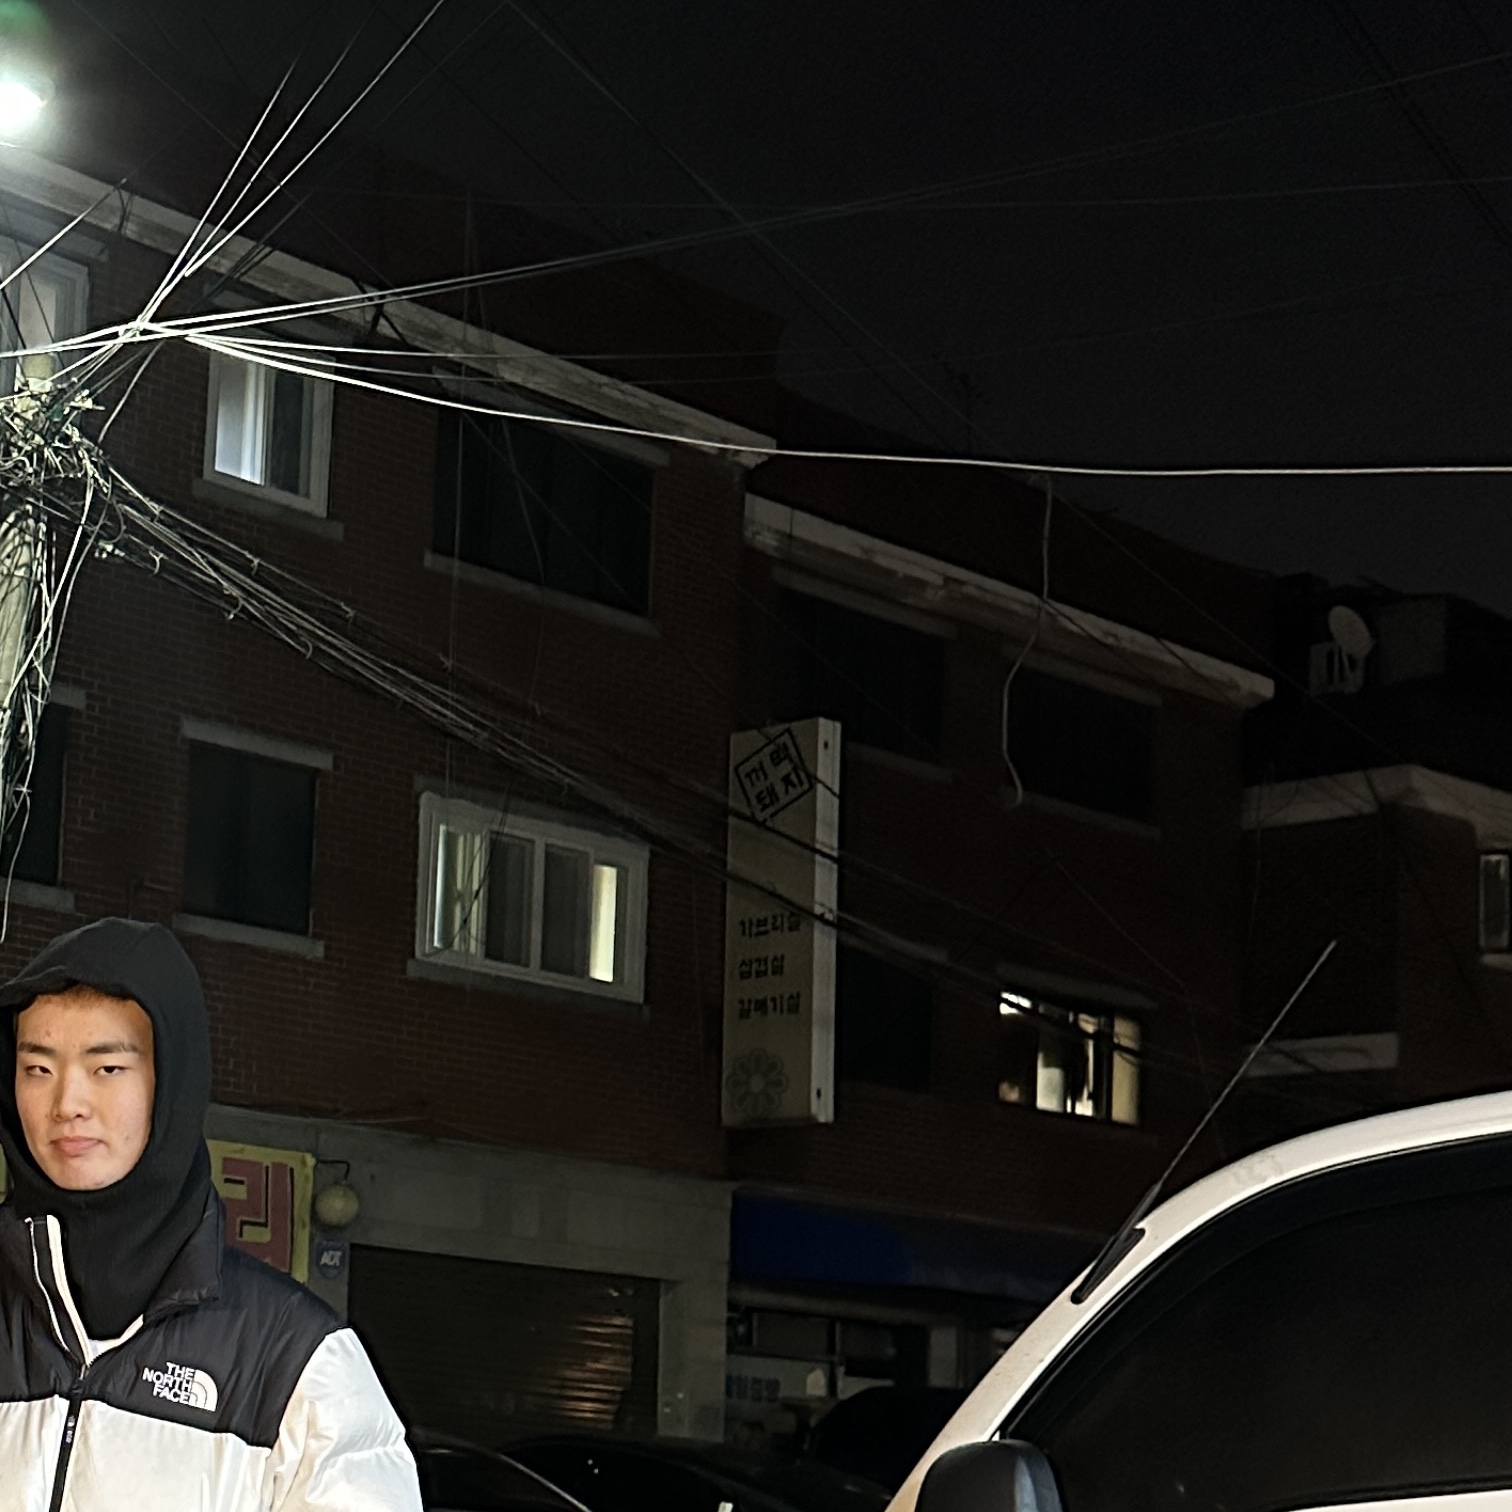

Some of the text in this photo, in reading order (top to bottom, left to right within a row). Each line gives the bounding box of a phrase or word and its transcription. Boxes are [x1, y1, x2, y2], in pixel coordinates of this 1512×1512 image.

[142, 1367, 193, 1392] NORTH
[166, 1361, 195, 1380] THE
[153, 1382, 191, 1405] FACE
